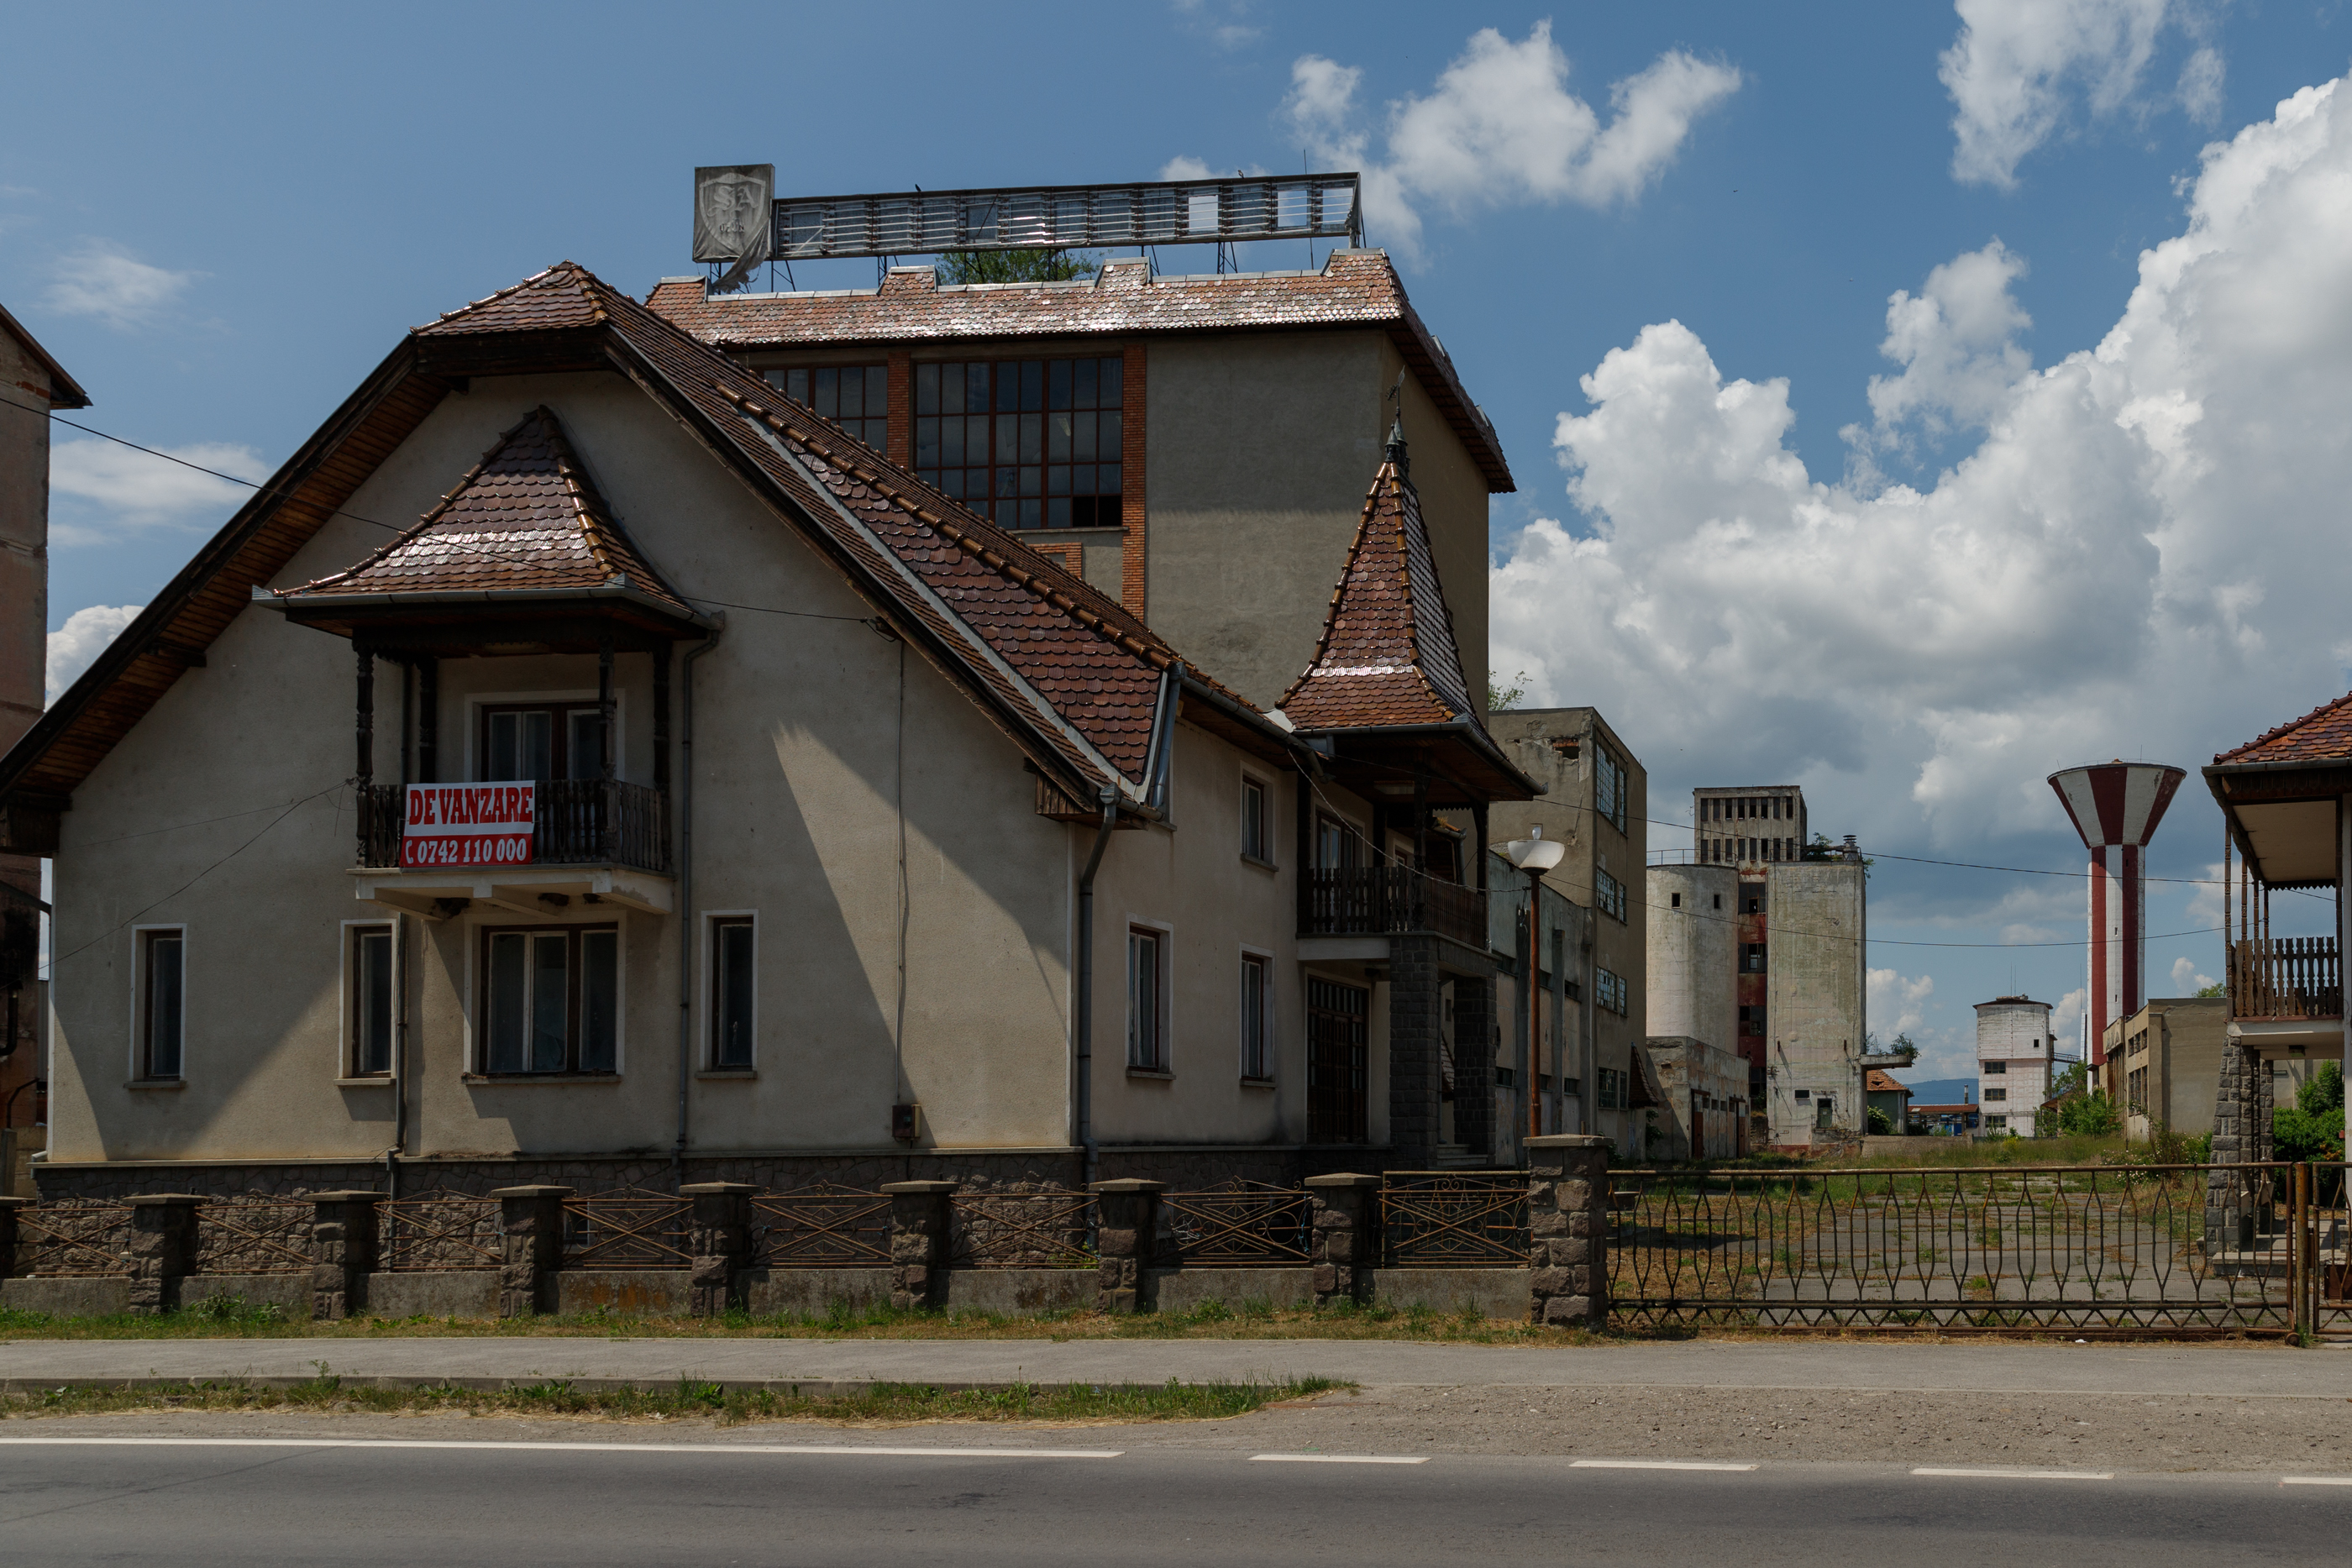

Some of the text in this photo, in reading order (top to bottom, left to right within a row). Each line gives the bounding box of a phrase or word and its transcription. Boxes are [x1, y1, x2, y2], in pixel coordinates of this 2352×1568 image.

[409, 787, 533, 825] DE VANZARE
[417, 838, 527, 863] 0742 110 000
